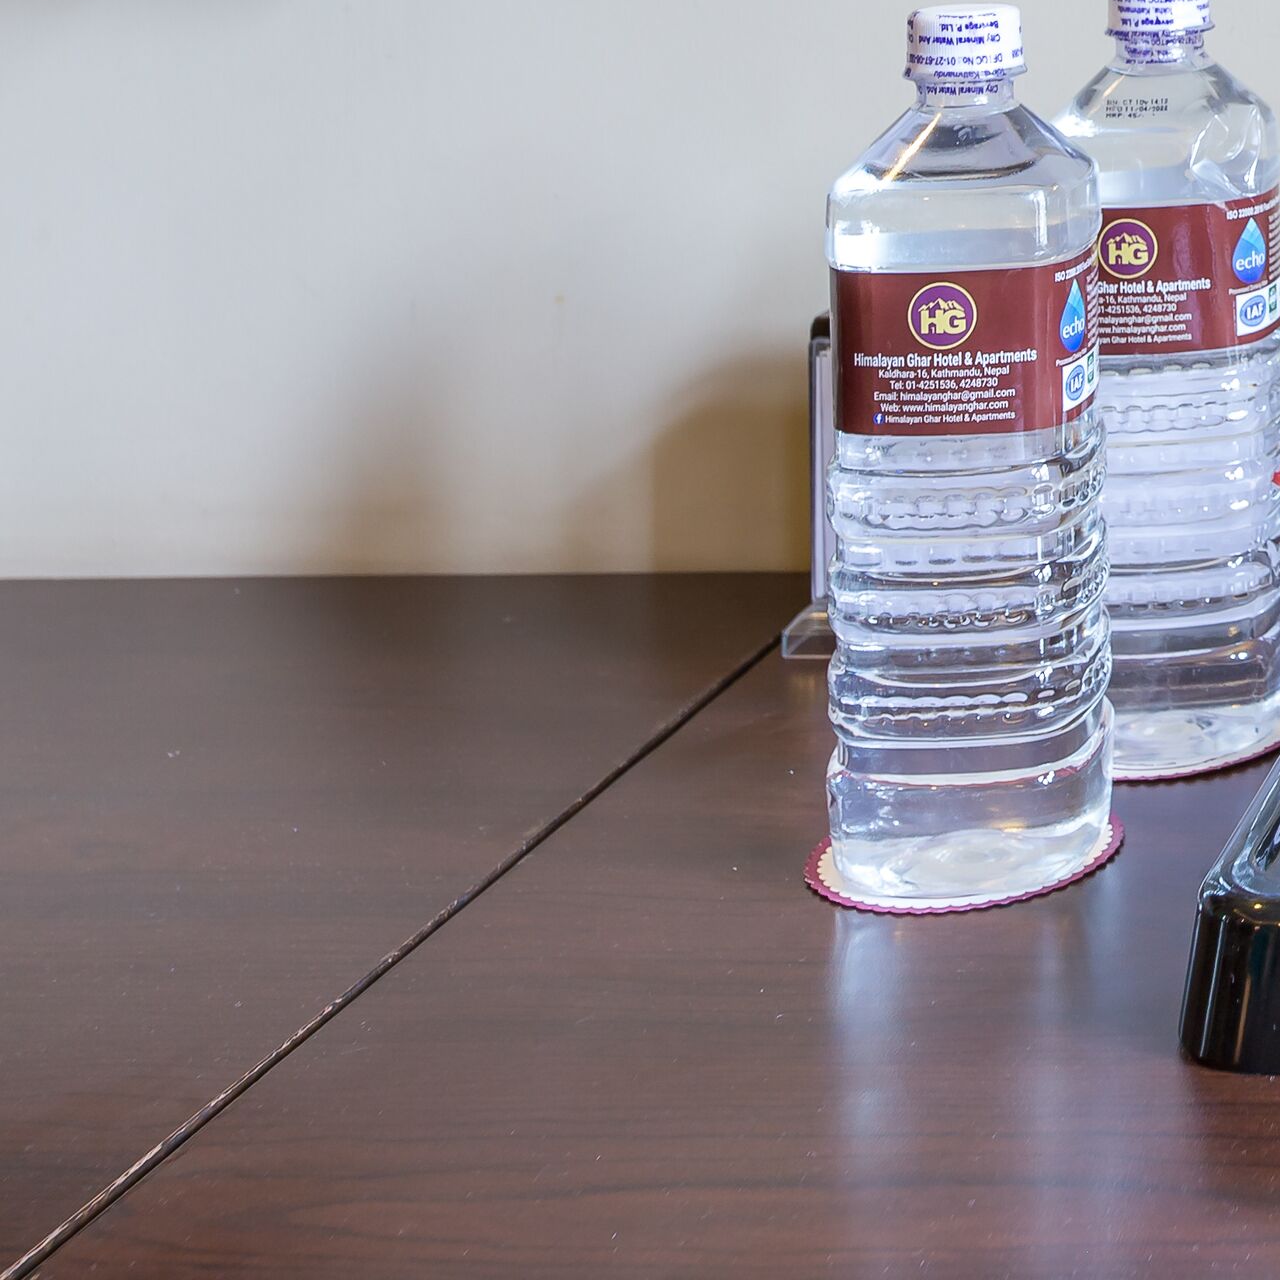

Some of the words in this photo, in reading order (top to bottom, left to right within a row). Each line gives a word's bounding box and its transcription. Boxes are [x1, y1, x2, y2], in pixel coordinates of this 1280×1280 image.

[933, 36, 954, 45] Water
[956, 36, 985, 45] Mineral
[1108, 242, 1149, 266] HG
[1235, 250, 1266, 272] echo
[1120, 280, 1145, 294] Hotel
[1146, 281, 1154, 293] &
[1156, 277, 1211, 295] Apartments
[1118, 294, 1163, 304] Kathmandu,
[1164, 292, 1187, 302] Nepal
[1143, 303, 1177, 312] 4248730
[1246, 302, 1264, 320] IAF
[921, 308, 967, 335] HG
[1098, 312, 1193, 326] malayanghar@gmail.com
[1062, 315, 1085, 339] echo
[1128, 334, 1147, 343] Hotel
[1153, 332, 1192, 344] Apartments
[854, 352, 905, 369] Himalayan
[906, 352, 931, 368] Ghar
[933, 351, 962, 367] Hotel
[964, 352, 973, 365] &
[974, 348, 1038, 368] Apartments
[878, 368, 930, 380] Kaldhara-16,
[931, 367, 982, 379] Kathmandu,
[984, 365, 1010, 377] Nepal
[889, 380, 904, 390] Tel:
[905, 379, 958, 391] 01-4251536,
[959, 377, 998, 389] 4248730
[1070, 370, 1083, 392] IAF
[873, 392, 899, 401] Email:
[900, 387, 1016, 403] himalayanghar@gmail.com
[880, 403, 901, 413] Web:
[902, 399, 1009, 413] www.himalayanghar.com
[885, 414, 923, 425] Himalayan
[923, 414, 942, 424] Ghar
[943, 412, 963, 423] Hotel
[964, 413, 971, 422] &
[972, 410, 1016, 423] Apartments
